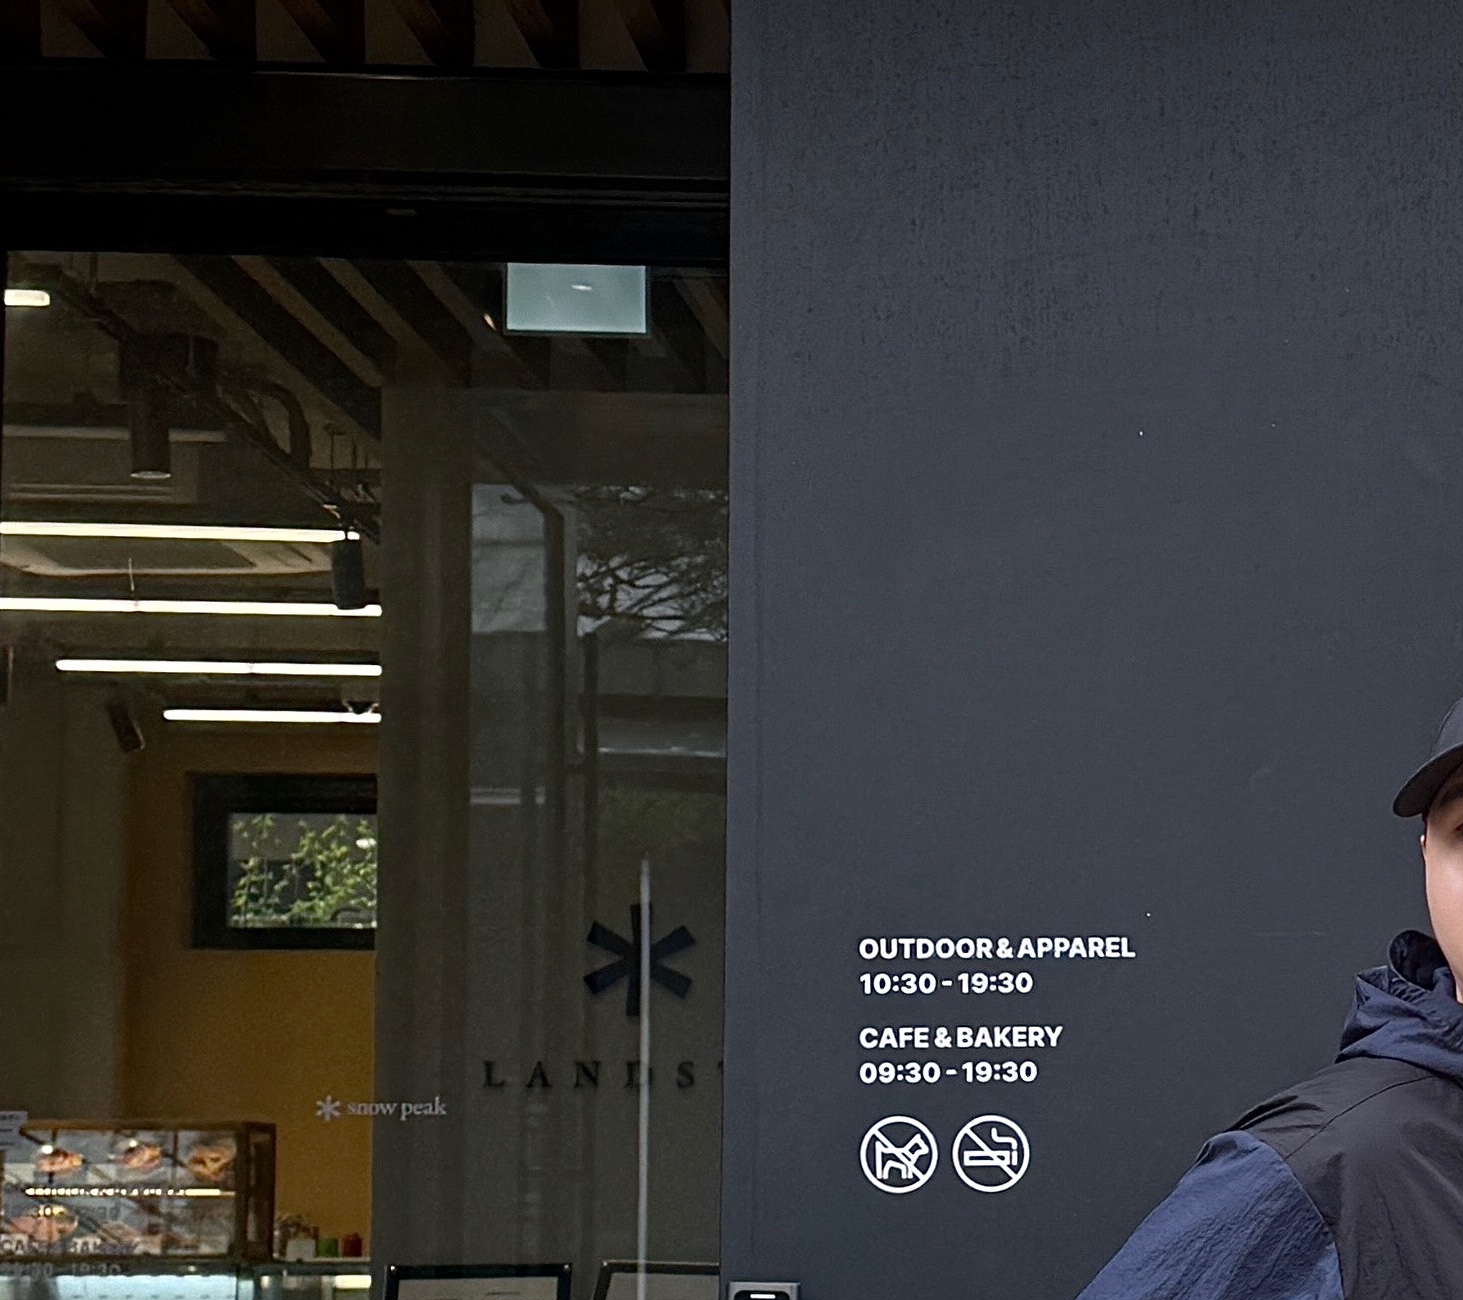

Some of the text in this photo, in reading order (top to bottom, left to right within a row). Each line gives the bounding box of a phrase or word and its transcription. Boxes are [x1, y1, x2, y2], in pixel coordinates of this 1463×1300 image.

[858, 936, 1137, 959] OUTDOOR & APPAREL
[859, 972, 937, 994] 10:30
[957, 971, 1034, 993] 19:30
[858, 1025, 1064, 1049] CAFE & BAKERY
[483, 1060, 724, 1089] LANDS
[858, 1061, 942, 1084] 09:30
[962, 1060, 1039, 1083] 19:30
[347, 1096, 447, 1120] snow peak
